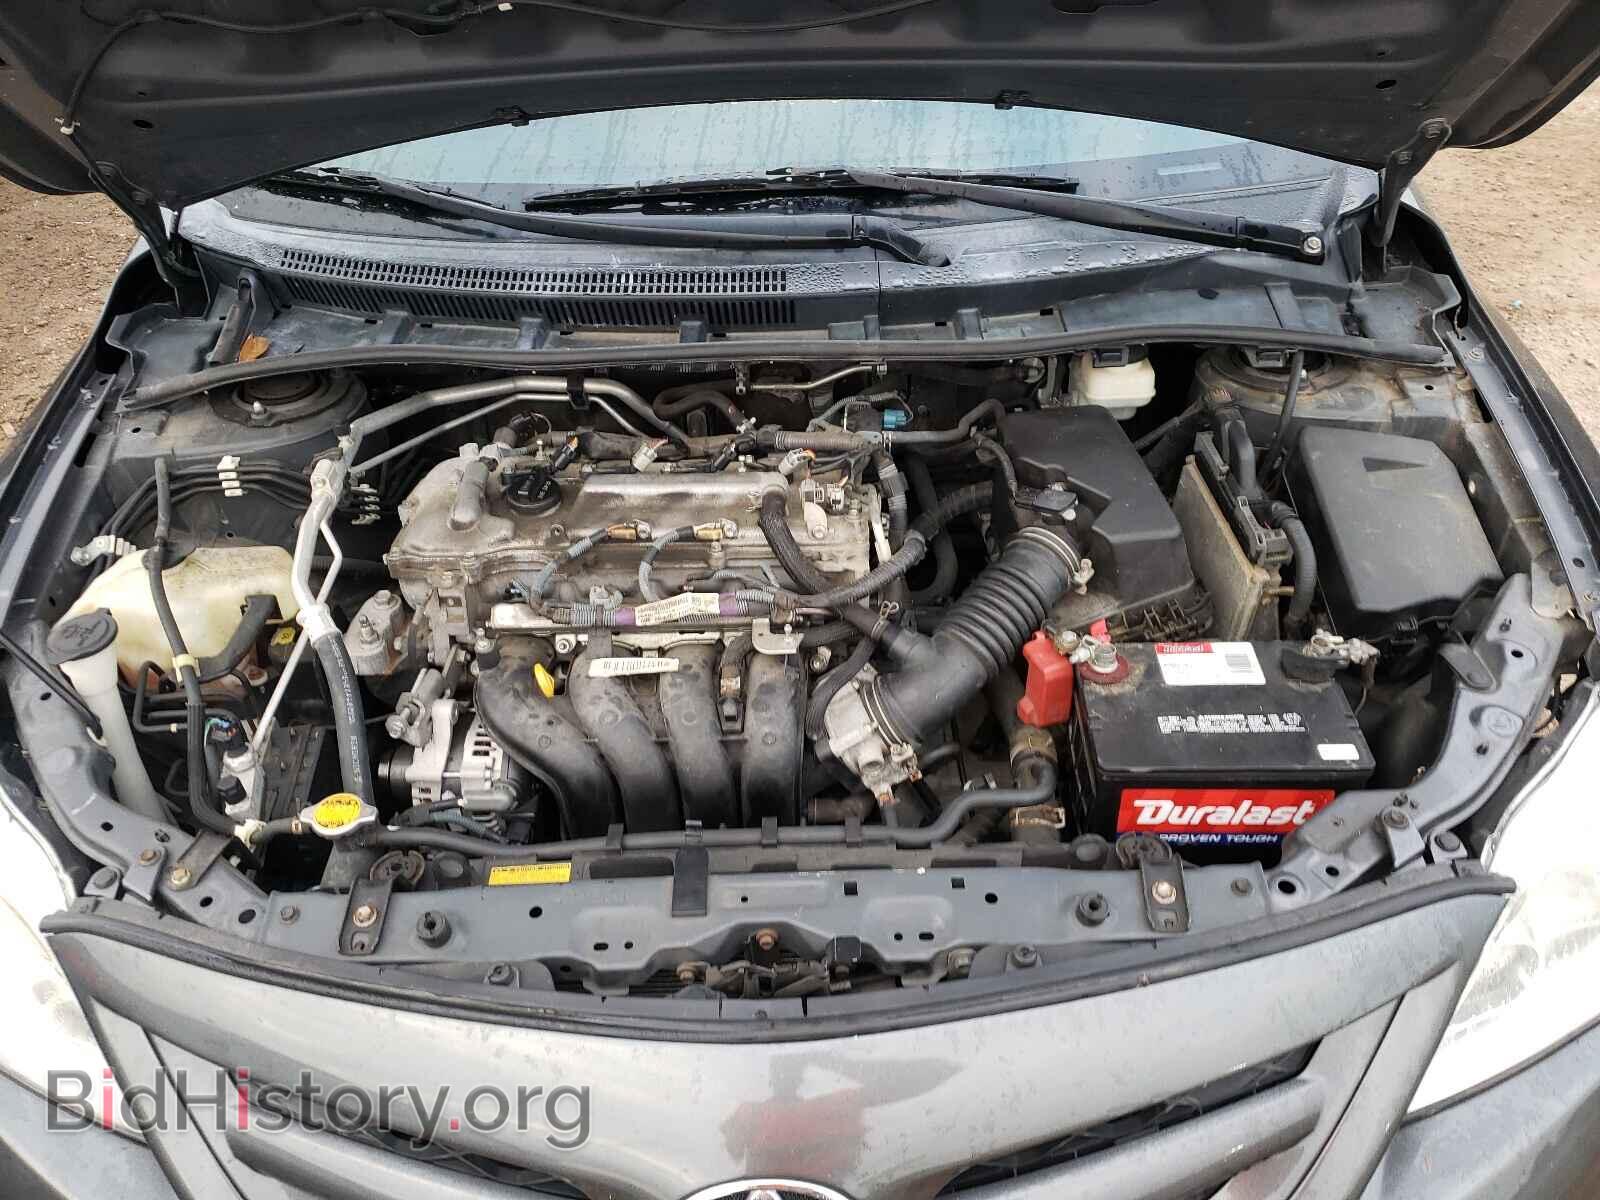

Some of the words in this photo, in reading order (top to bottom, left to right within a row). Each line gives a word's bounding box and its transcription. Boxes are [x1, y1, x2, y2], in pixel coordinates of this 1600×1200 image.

[1133, 799, 1315, 825] Duralast
[1159, 833, 1221, 844] PROVEN
[1226, 833, 1279, 844] TOUGH
